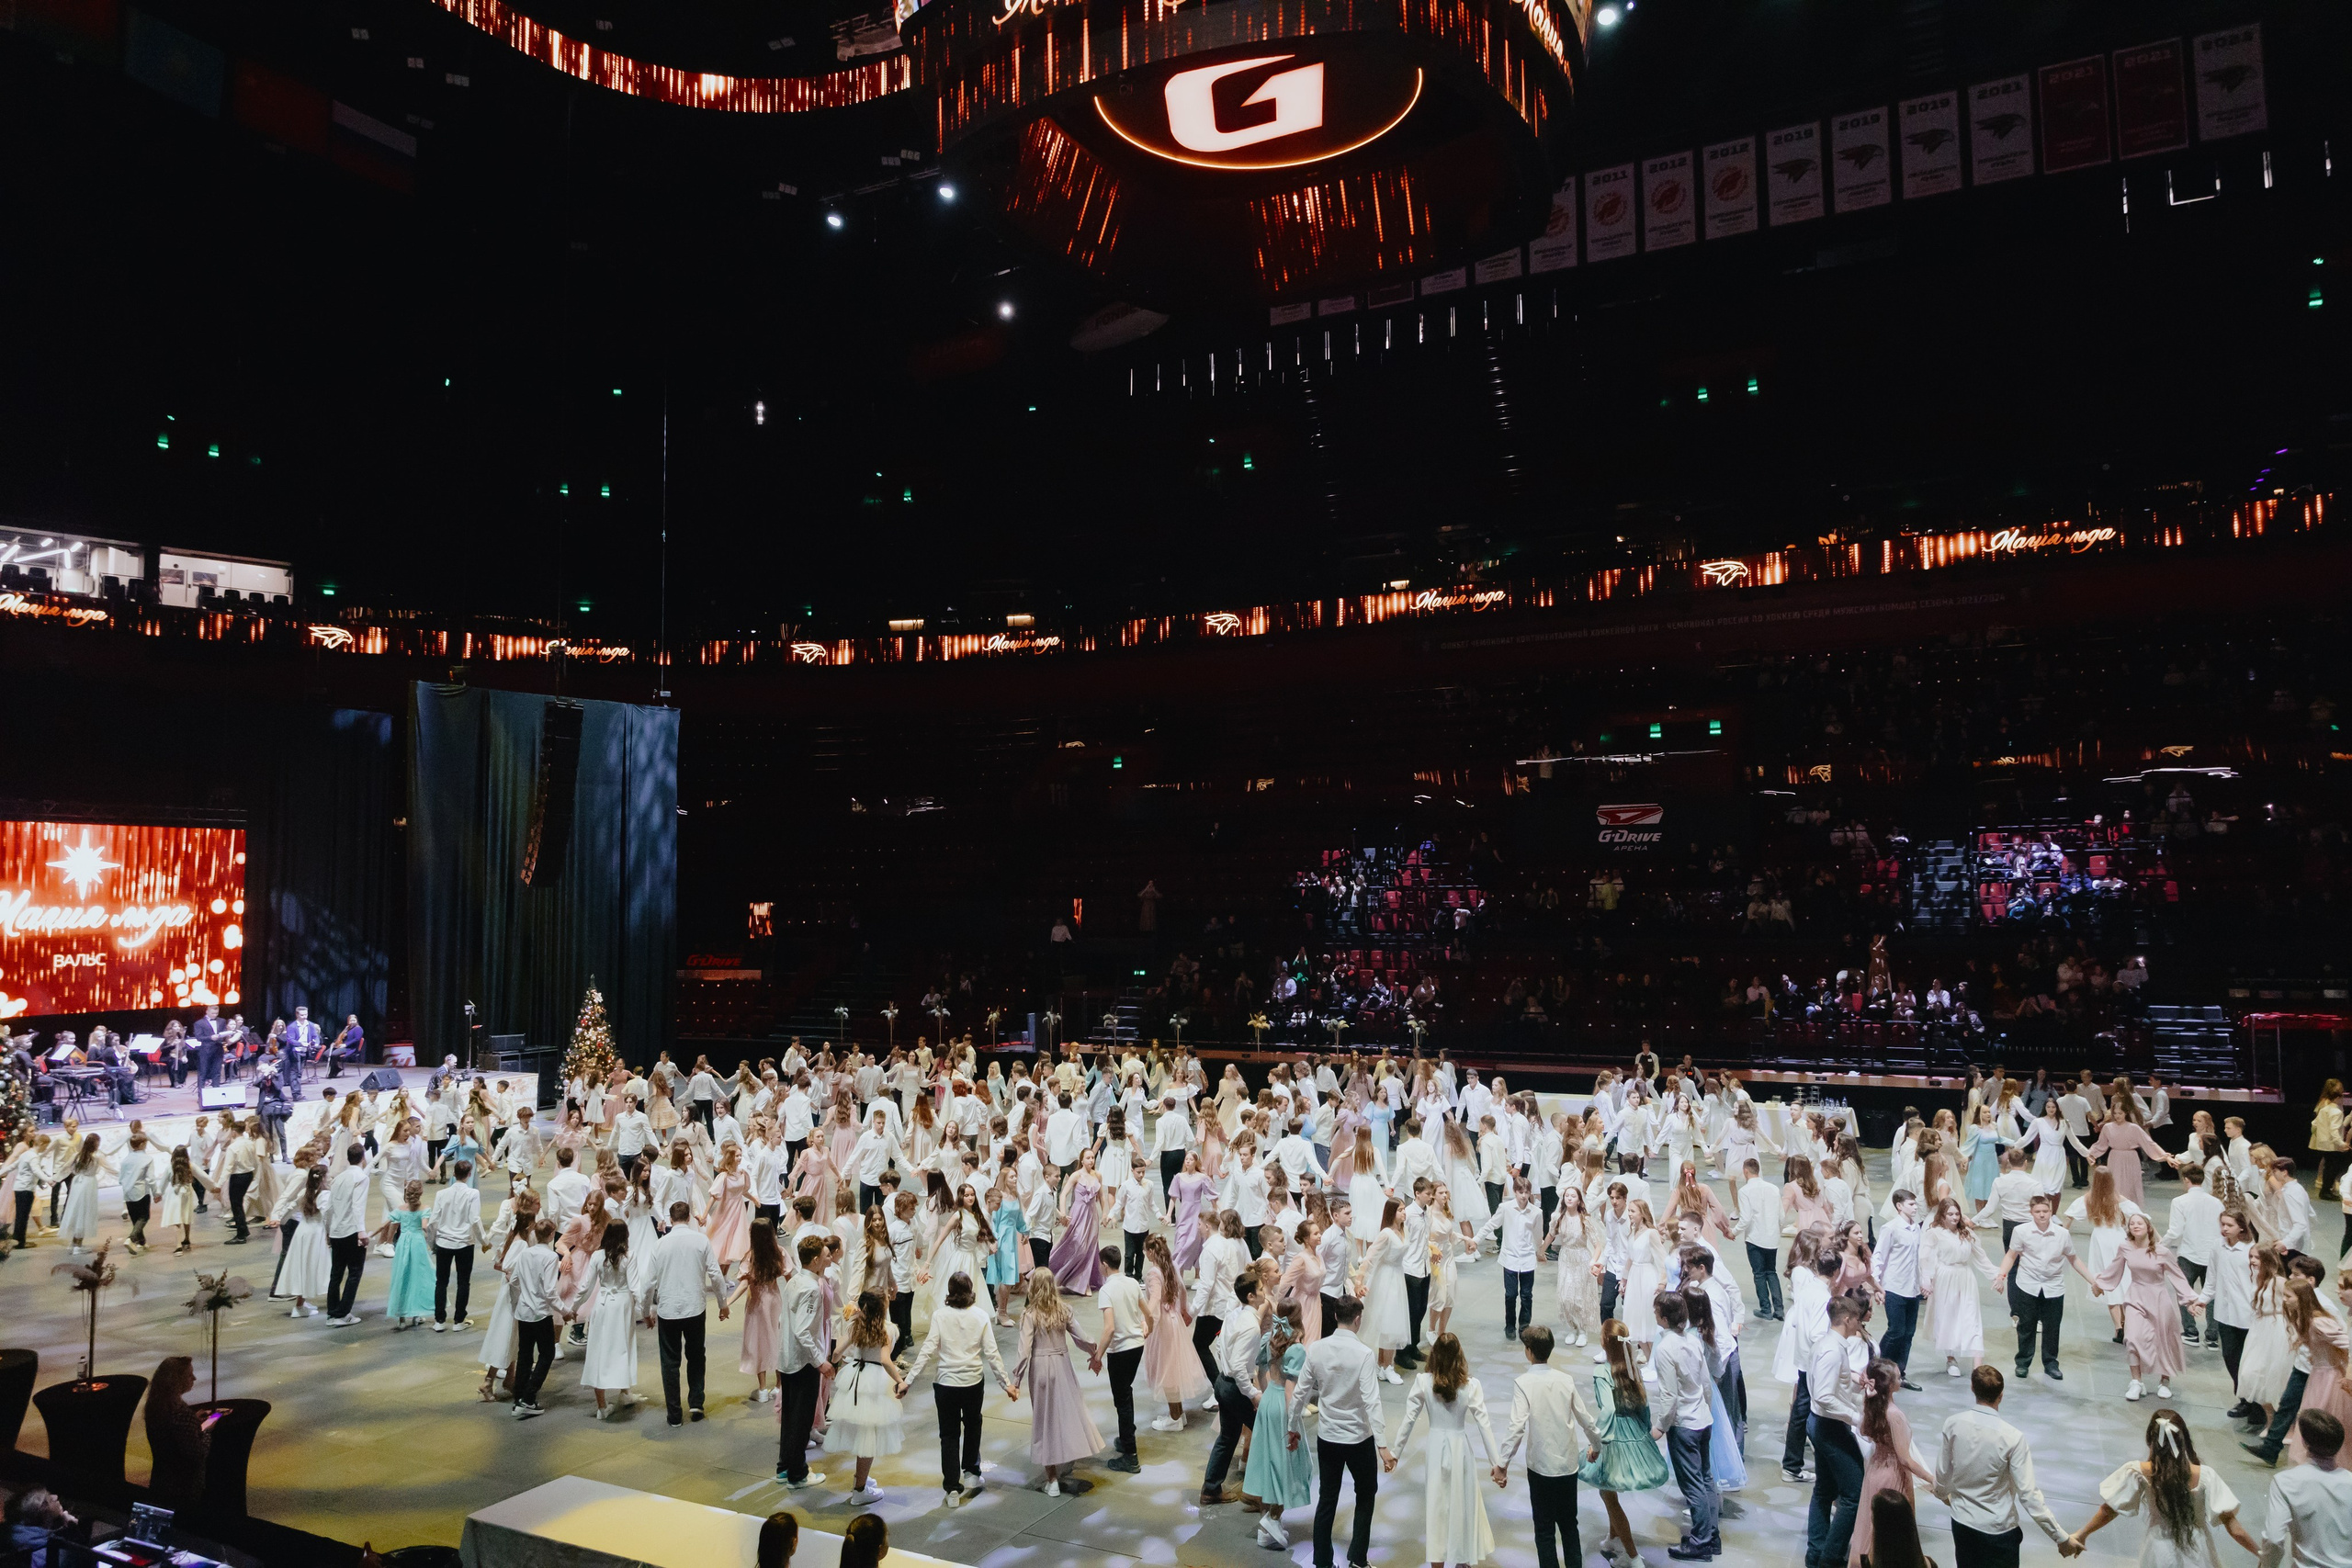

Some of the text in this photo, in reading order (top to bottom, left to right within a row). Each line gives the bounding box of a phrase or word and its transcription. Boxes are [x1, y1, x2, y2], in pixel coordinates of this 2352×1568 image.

[1710, 143, 1749, 160] 2012
[1649, 156, 1687, 175] 2012
[1591, 170, 1629, 186] 2011
[1982, 527, 2116, 554] Магия льда
[1409, 590, 1506, 612] Магия льда
[62, 608, 107, 626] льда
[1471, 637, 1514, 648] ЧЕМПИОНАТ
[1589, 625, 1636, 637] ХОККЕЙНОЙ
[1638, 623, 1659, 633] ЛИГИ
[1667, 619, 1715, 630] ЧЕМПИОНАТ
[1717, 616, 1749, 626] РОССИИ
[1766, 612, 1801, 622] ХОККЕЮ
[1803, 608, 1830, 618] СРЕДИ
[1833, 604, 1876, 615] МУЖСКИХ
[1879, 601, 1917, 612] КОМАНД
[1919, 598, 1954, 608] СЕЗОНА
[982, 635, 1060, 655] Магия льда
[596, 647, 630, 663] льда
[109, 905, 194, 948] льда
[53, 953, 107, 968] ВАЛЬС
